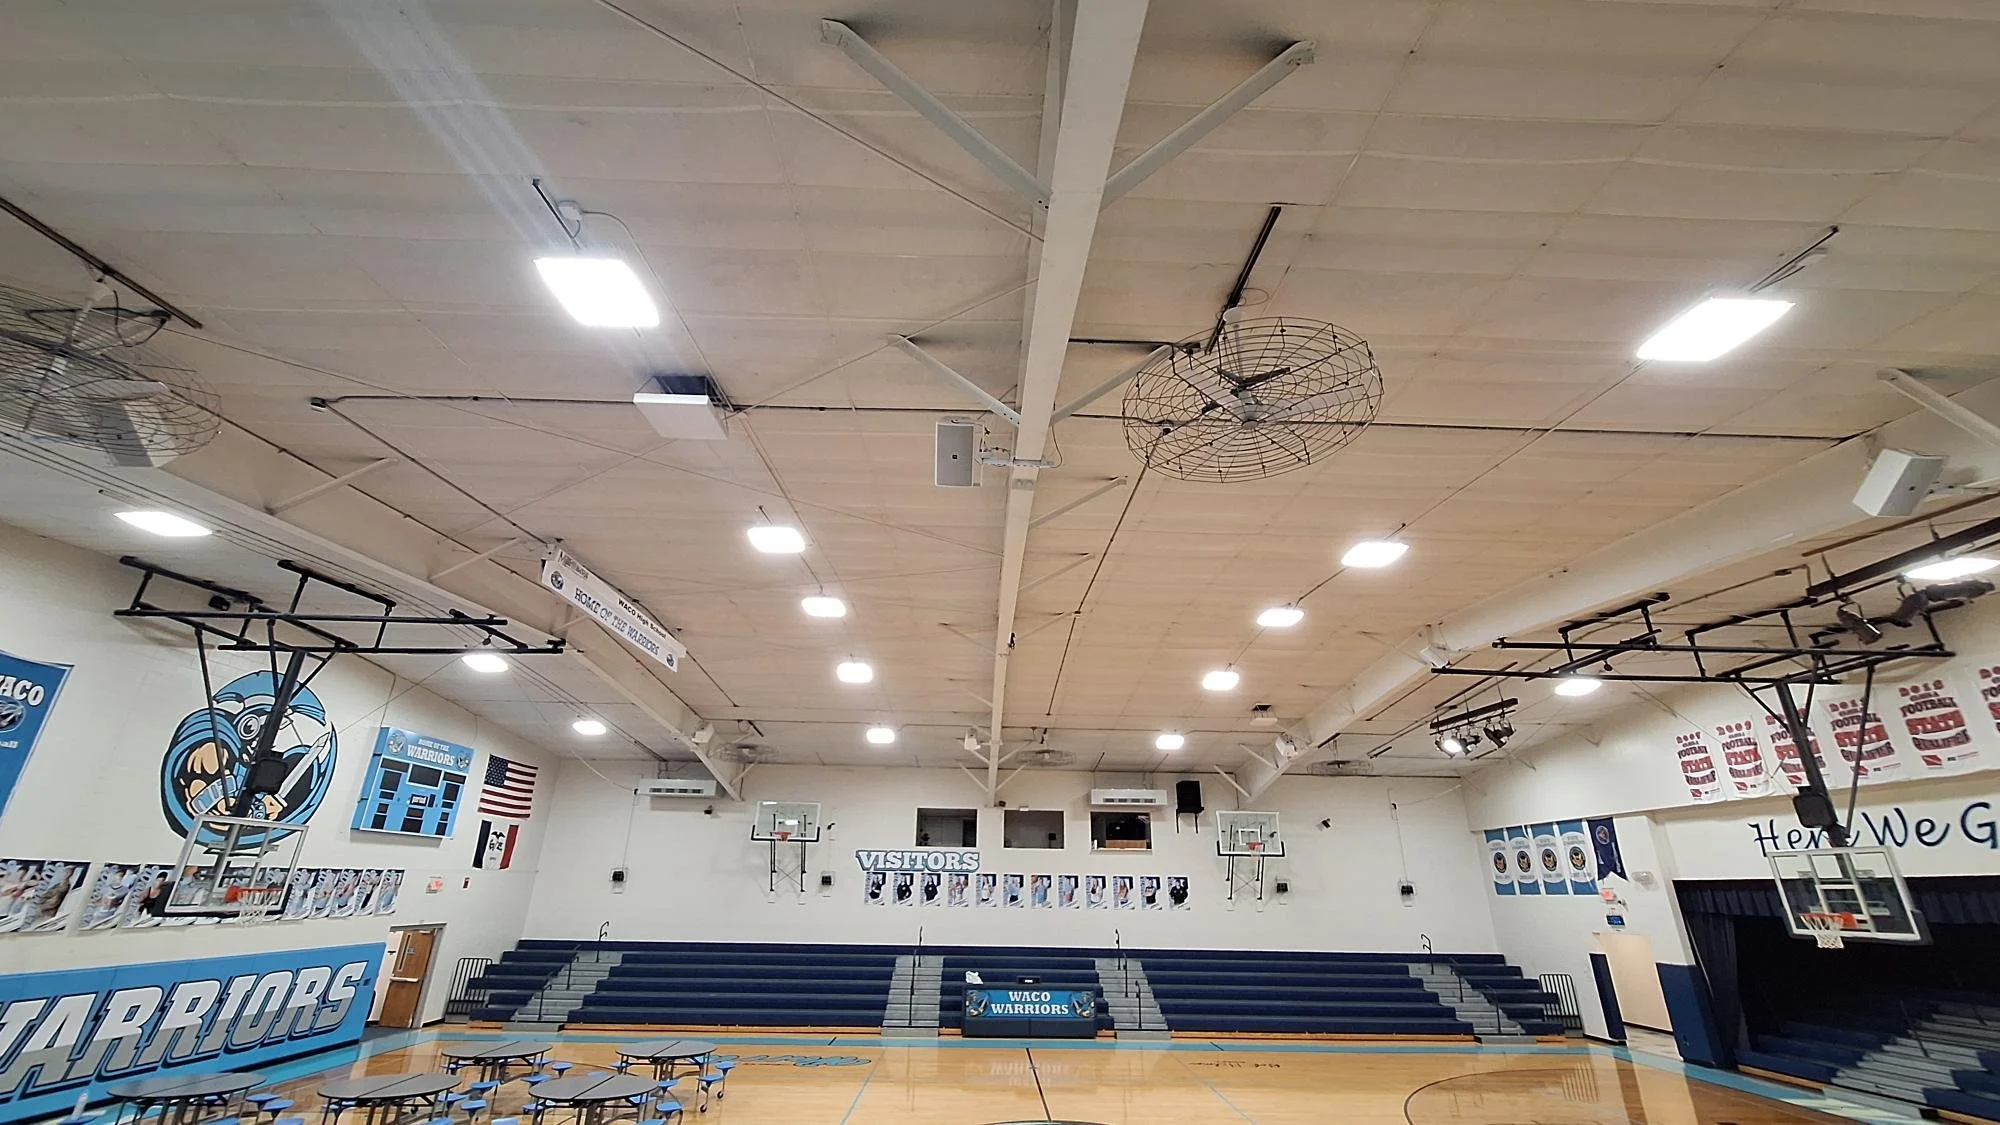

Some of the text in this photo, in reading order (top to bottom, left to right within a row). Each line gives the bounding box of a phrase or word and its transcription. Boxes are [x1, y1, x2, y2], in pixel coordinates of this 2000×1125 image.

[574, 588, 660, 656] HOME OF THE WARRIORS
[618, 598, 667, 639] WACO High School
[0, 675, 45, 706] ACO
[1899, 697, 1958, 717] FOOTBALL
[1905, 709, 1965, 735] STATE
[1721, 737, 1757, 752] FOOTBALL
[1911, 728, 1971, 751] QUALIFIER
[407, 744, 455, 766] WARRIORS
[1677, 745, 1708, 759] FOOTBALL
[1725, 748, 1762, 765] STATE
[1681, 756, 1714, 773] STATE
[1860, 806, 1950, 848] We
[857, 850, 980, 872] VISITORS
[1008, 991, 1051, 1002] WACO
[991, 1003, 1069, 1015] WARRIORS
